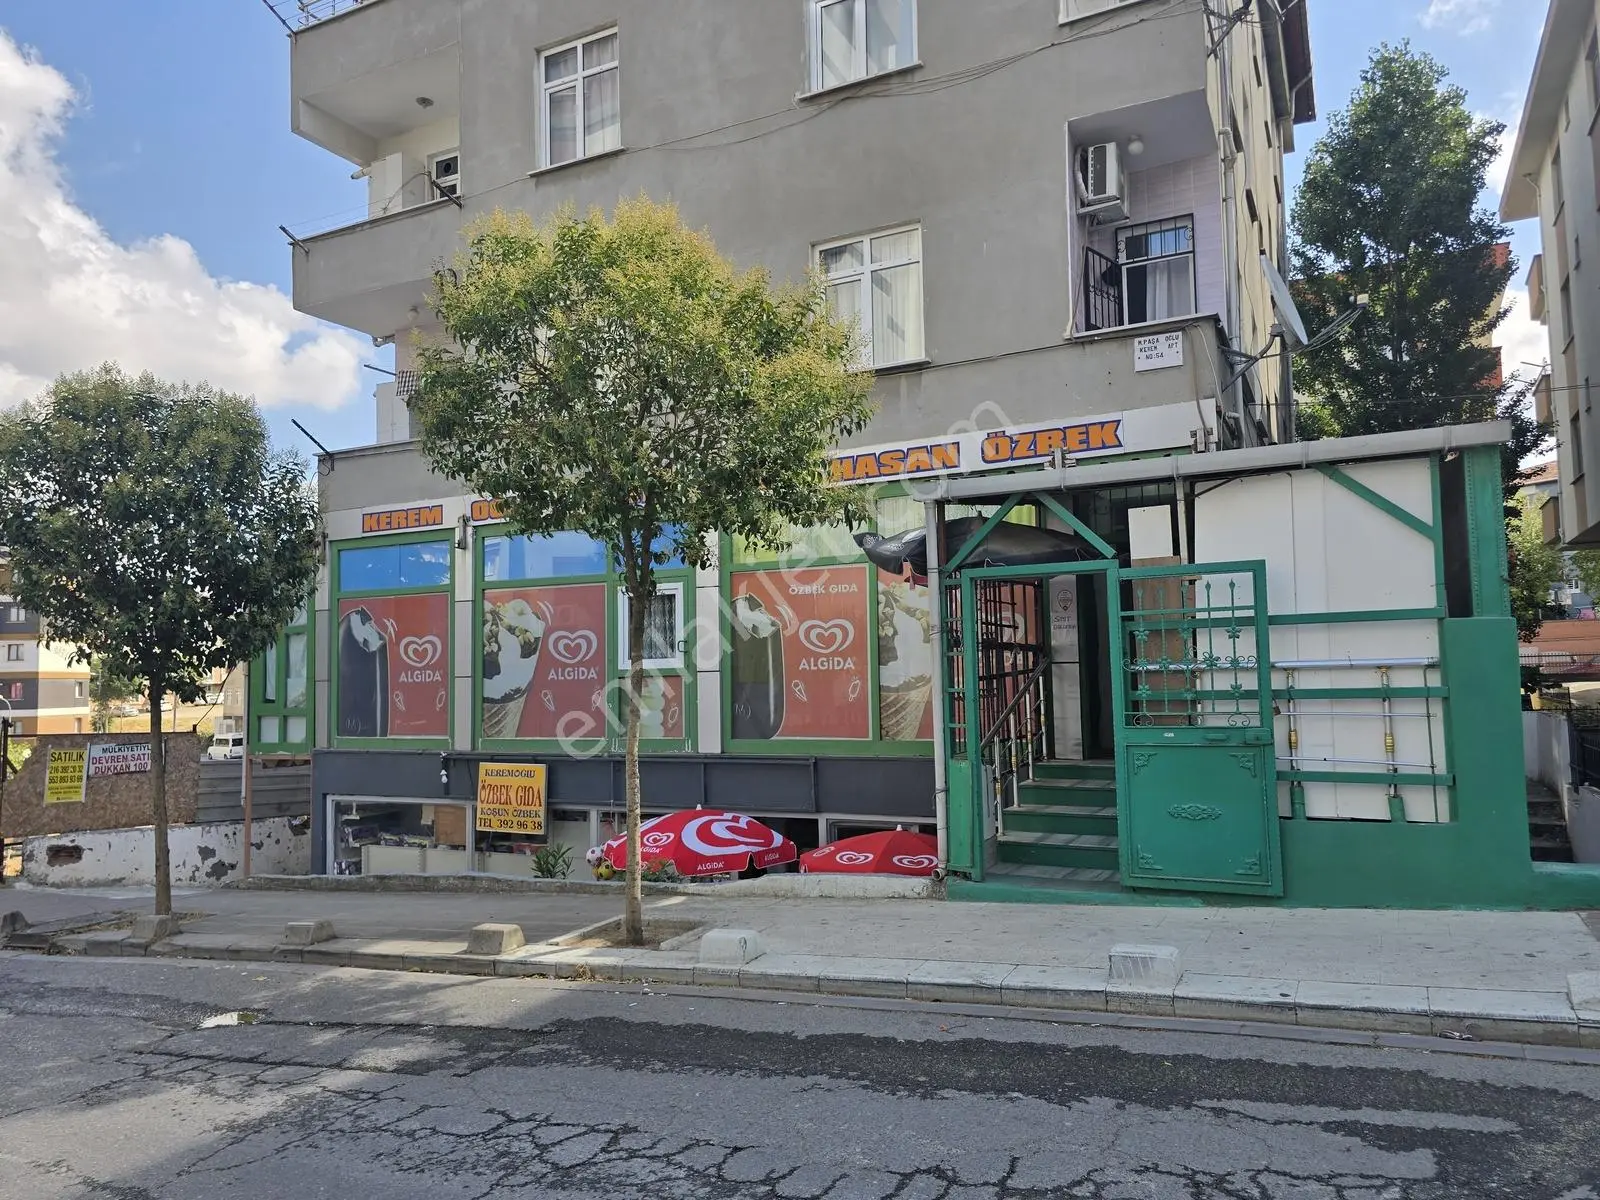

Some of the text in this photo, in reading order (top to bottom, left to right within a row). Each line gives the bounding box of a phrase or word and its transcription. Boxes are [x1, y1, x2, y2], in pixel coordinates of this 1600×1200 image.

[829, 441, 960, 482] HASAN
[362, 504, 443, 533] KEREM
[829, 583, 858, 593] GIDA
[102, 744, 152, 754] MÜLKİYETİYL
[50, 751, 85, 762] SATILIK
[92, 752, 151, 765] DEVREN SATI
[480, 779, 542, 807] ÖZBEK GIDA
[512, 806, 541, 818] ÖZBEK
[497, 820, 514, 829] 392
[516, 821, 528, 830] 96
[531, 821, 543, 830] 38
